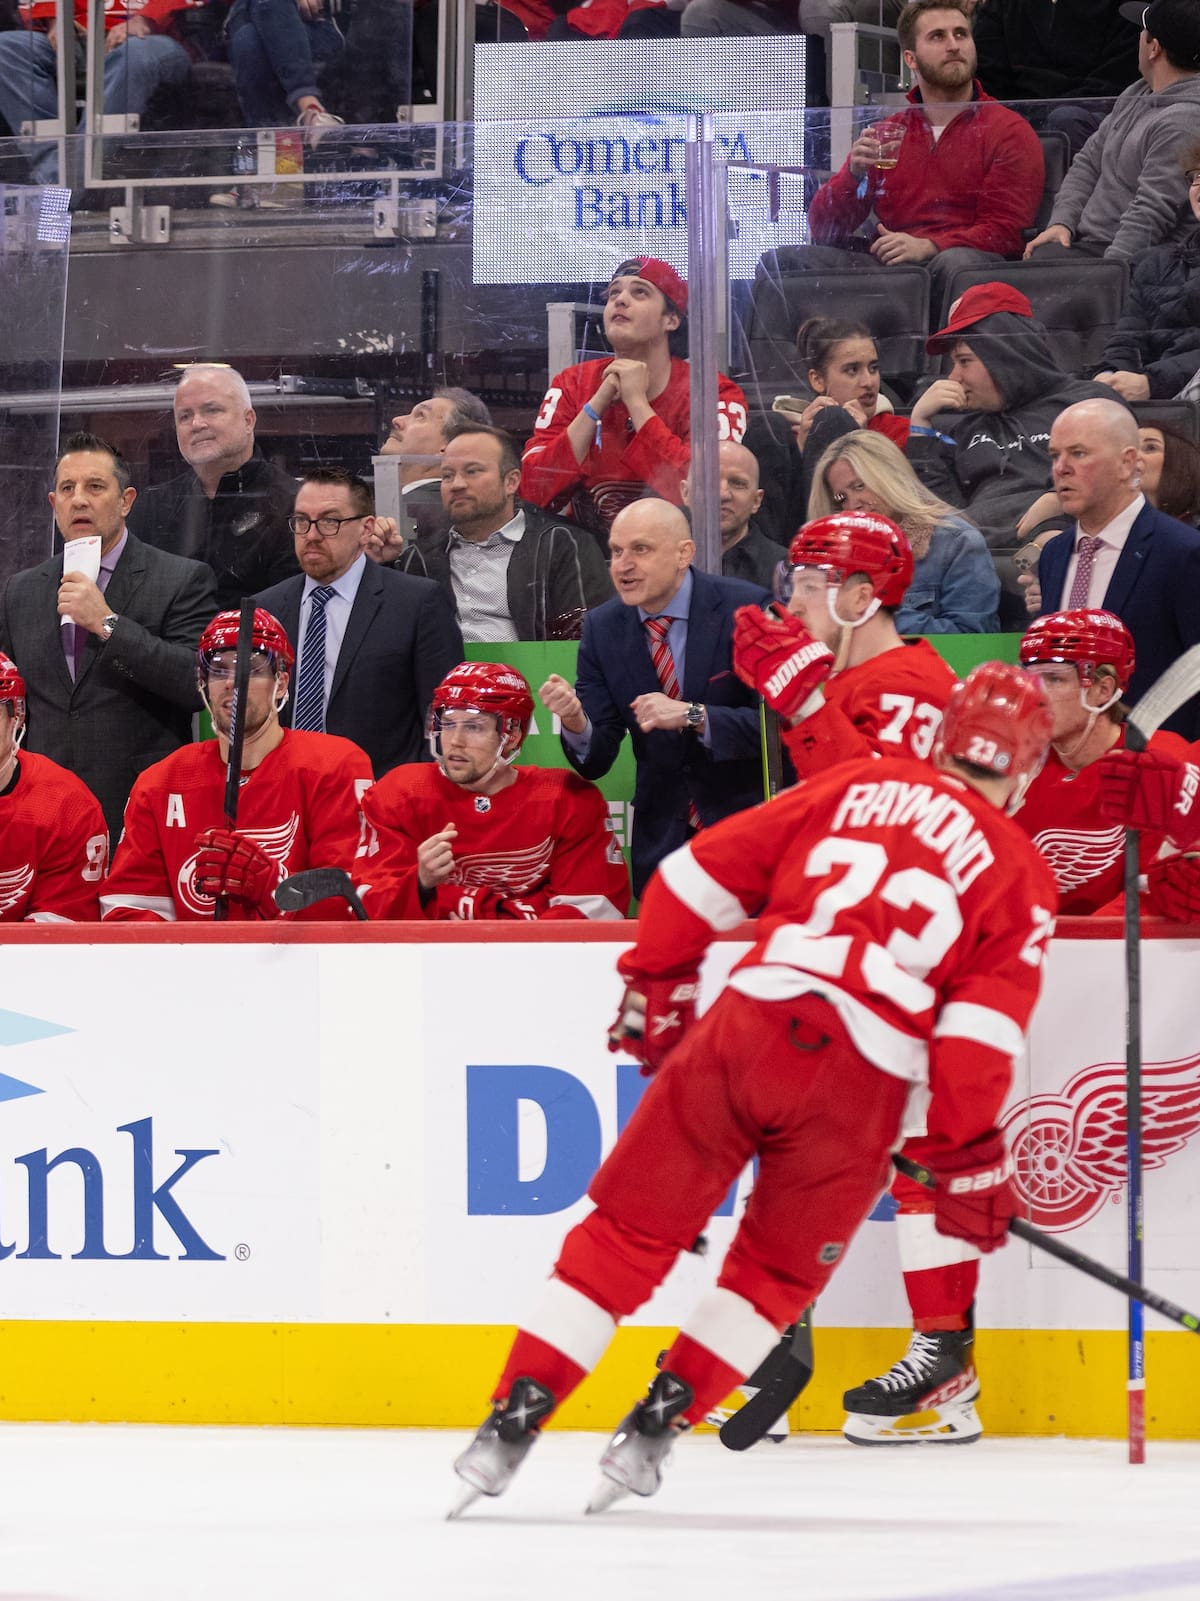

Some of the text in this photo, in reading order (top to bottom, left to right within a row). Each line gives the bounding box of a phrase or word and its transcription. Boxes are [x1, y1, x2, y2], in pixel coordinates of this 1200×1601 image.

[514, 130, 762, 187] ComerA
[215, 626, 241, 636] CC
[877, 692, 944, 760] 73
[965, 735, 998, 764] 23
[165, 793, 187, 828] A
[830, 780, 995, 896] RAYMOND
[81, 829, 110, 881] 8
[764, 836, 964, 1015] 23
[1019, 904, 1056, 967] 2
